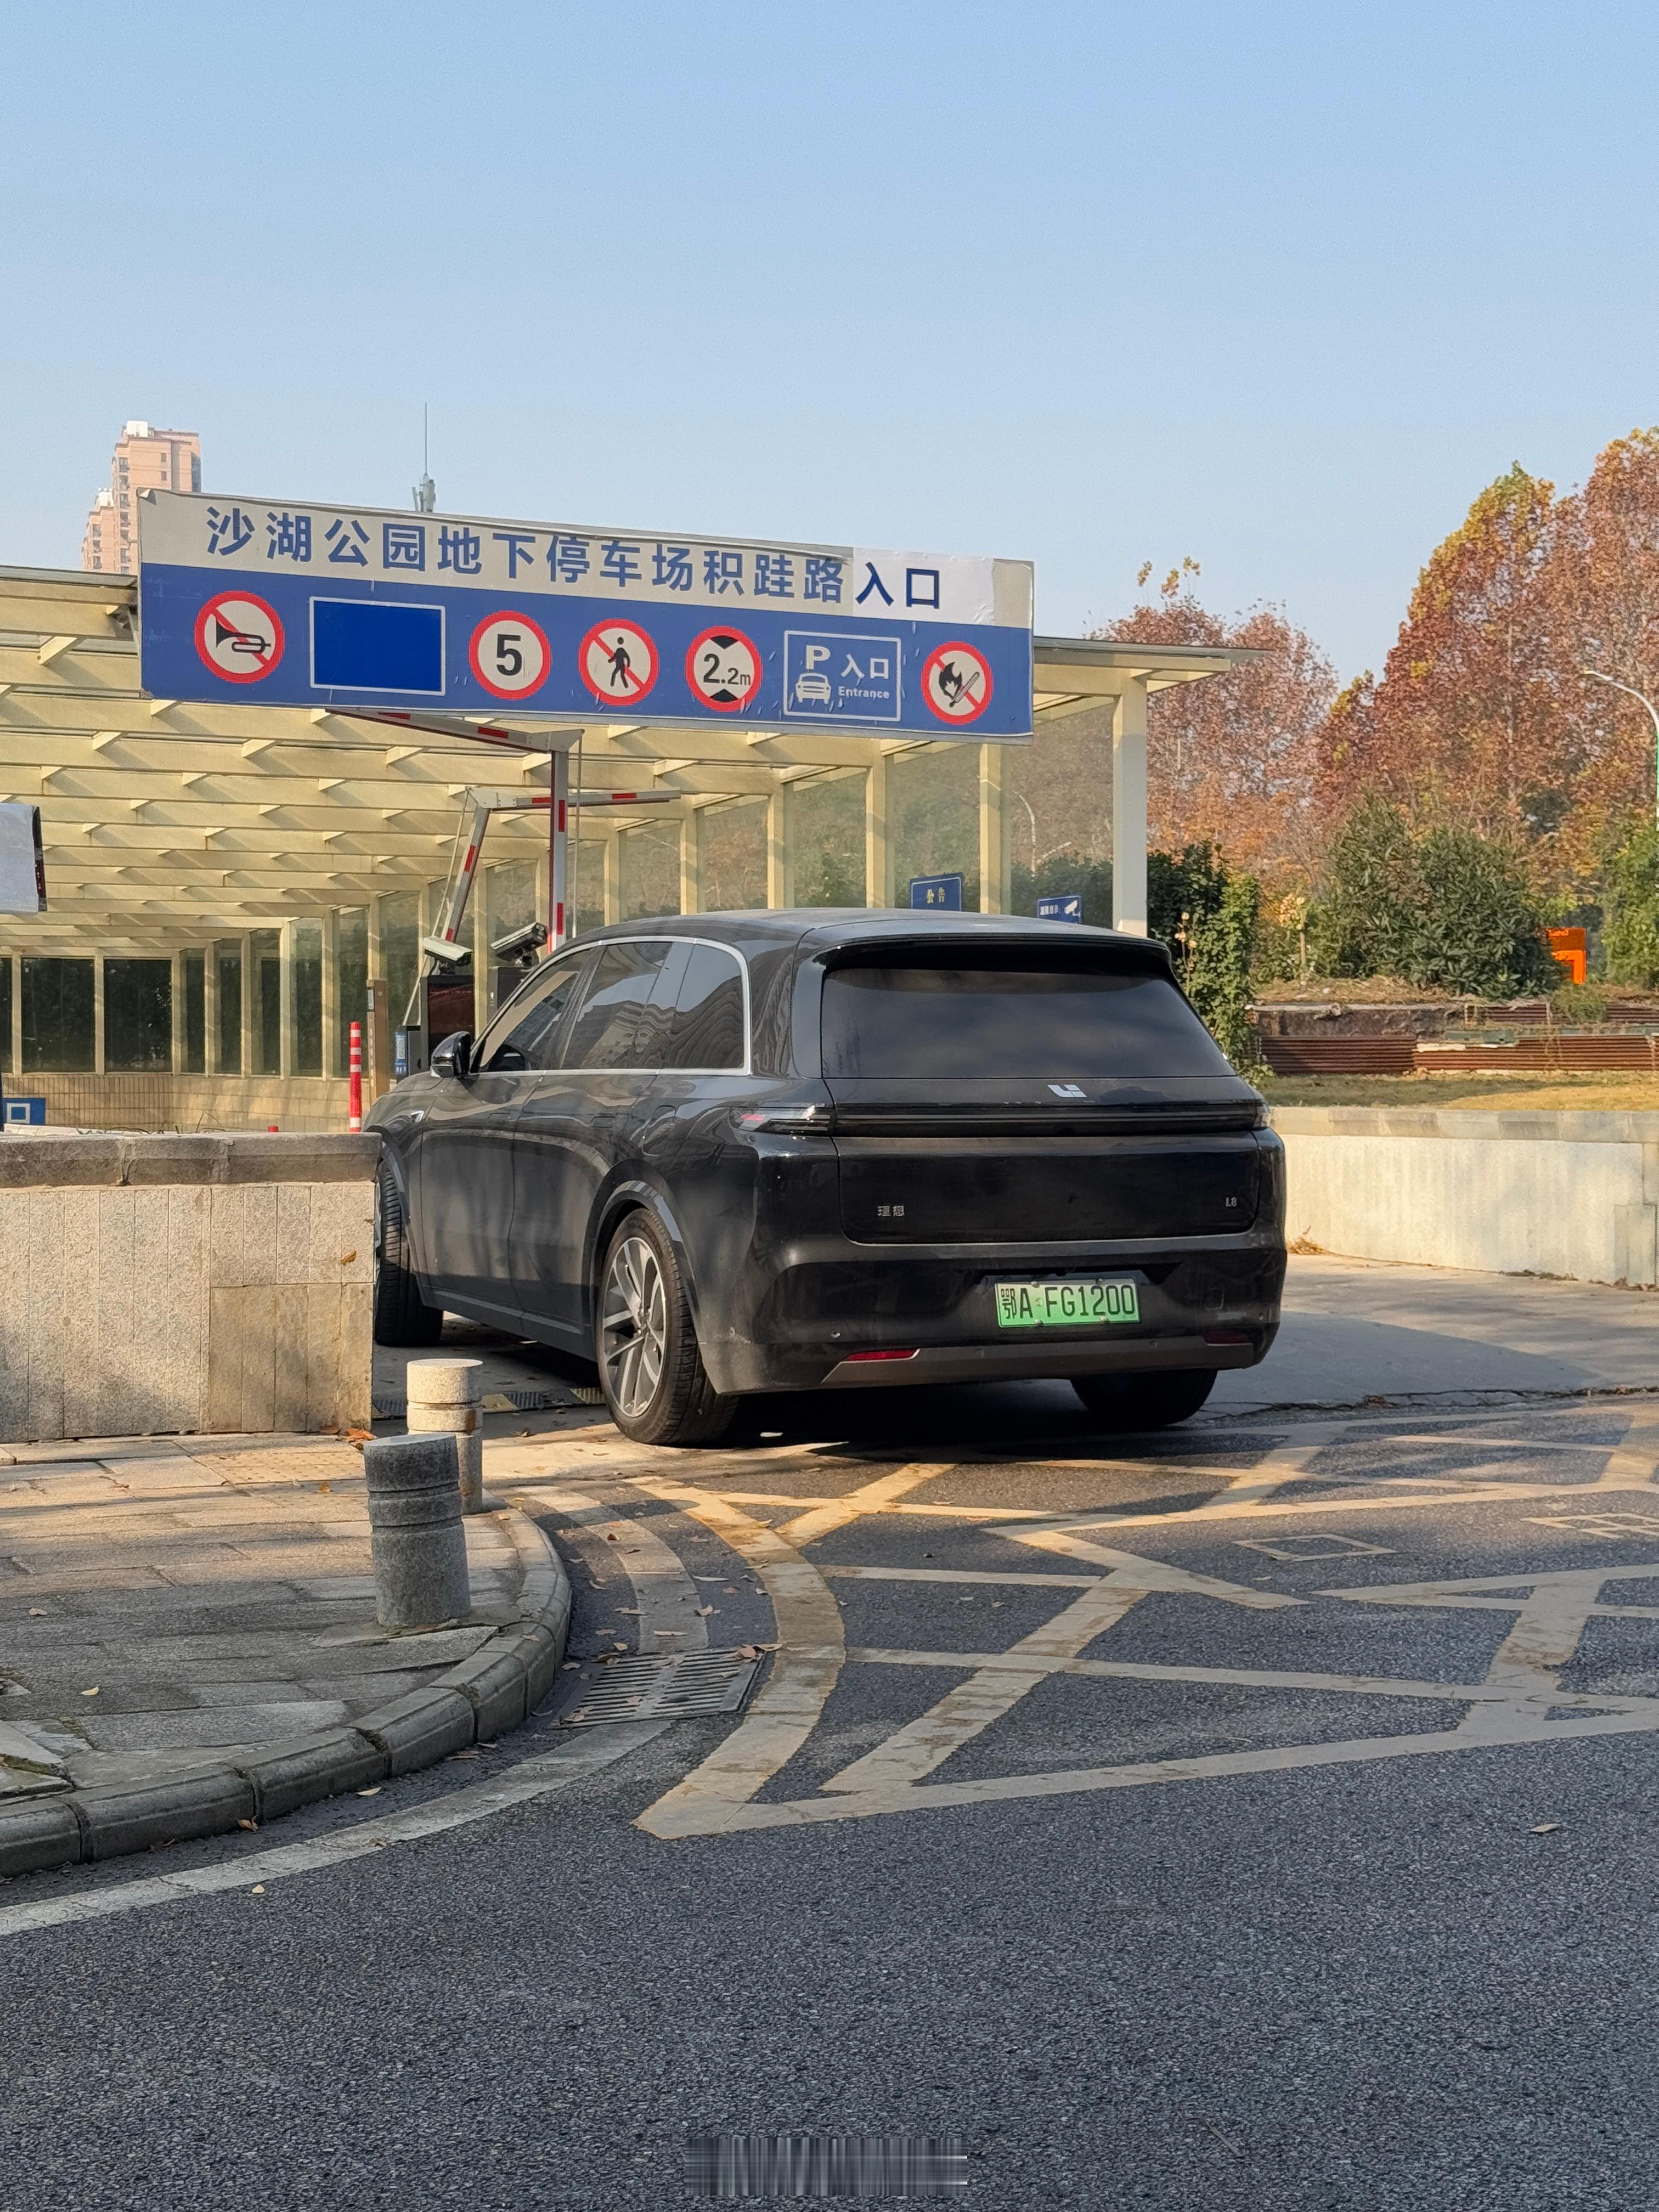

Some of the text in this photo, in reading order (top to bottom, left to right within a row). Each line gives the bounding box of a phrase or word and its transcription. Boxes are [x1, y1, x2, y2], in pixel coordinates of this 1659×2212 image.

[206, 506, 940, 610] 沙湖公园地下停车场积跬路入口
[496, 634, 522, 676] 5
[703, 653, 751, 686] 2.2m
[806, 645, 831, 670] P
[840, 654, 889, 680] 入口
[838, 686, 890, 699] Entrance
